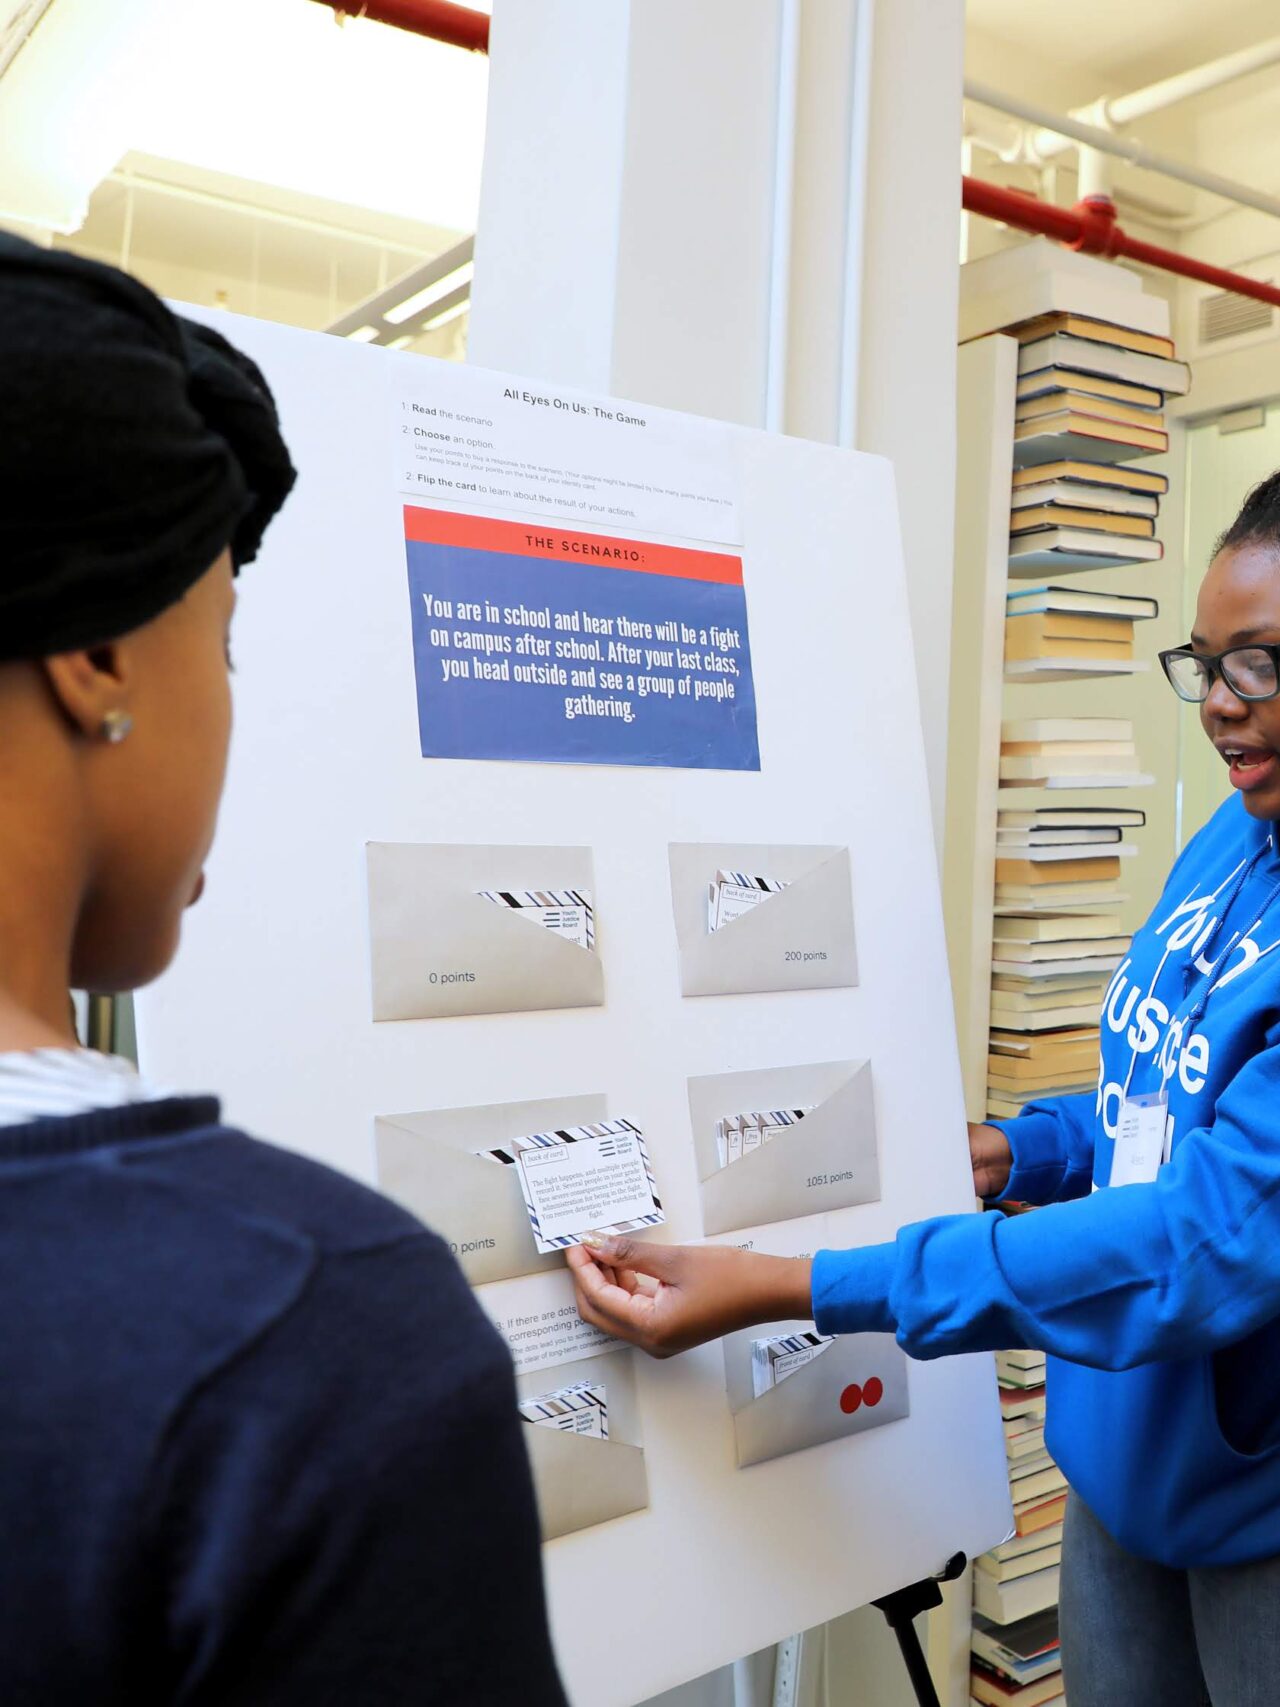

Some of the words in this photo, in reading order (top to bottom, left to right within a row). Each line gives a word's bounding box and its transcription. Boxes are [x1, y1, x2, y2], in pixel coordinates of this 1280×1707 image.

[412, 404, 437, 416] Read
[439, 406, 453, 420] the
[456, 414, 494, 427] scenario
[504, 388, 519, 400] All
[522, 392, 550, 407] Eyes
[553, 398, 569, 410] On
[572, 404, 590, 415] Us:
[594, 407, 613, 420] The
[616, 412, 646, 427] Game
[414, 428, 450, 442] Choose
[453, 436, 464, 444] an
[466, 438, 496, 450] option.
[429, 447, 442, 456] your
[418, 474, 436, 485] Flip
[438, 476, 453, 488] the
[456, 480, 477, 492] card
[479, 484, 487, 493] to
[489, 486, 512, 497] learn
[514, 490, 537, 501] about
[538, 492, 552, 504] the
[554, 496, 577, 508] result
[578, 500, 586, 509] of
[588, 503, 605, 513] your
[608, 506, 636, 518] actions.
[526, 536, 554, 550] THE
[562, 541, 645, 562] SCENARIO:
[423, 594, 452, 618] You
[457, 602, 481, 620] are
[485, 600, 500, 624] in
[504, 604, 550, 628] school
[554, 610, 580, 632] and
[582, 612, 614, 635] hear
[616, 616, 652, 639] there
[654, 621, 678, 642] will
[681, 623, 696, 644] be
[700, 630, 708, 646] a
[710, 626, 740, 652] fight
[430, 628, 450, 647] on
[454, 630, 512, 656] campus
[516, 632, 552, 656] after
[555, 638, 604, 662] school.
[608, 642, 642, 664] After
[646, 648, 674, 670] your
[676, 648, 702, 670] last
[704, 652, 740, 677] class,
[442, 658, 469, 682] you
[473, 656, 510, 682] head
[514, 662, 567, 686] outside
[571, 667, 596, 688] and
[600, 672, 623, 690] see
[626, 675, 634, 691] a
[638, 675, 674, 699] group
[678, 675, 691, 696] of
[694, 678, 735, 702] people
[565, 694, 636, 722] gathering.
[1155, 883, 1262, 995] Youh
[784, 950, 802, 961] 200
[804, 950, 828, 962] points
[429, 973, 438, 984] 0
[440, 972, 476, 986] points
[807, 1174, 828, 1188] 1051
[830, 1171, 854, 1184] points
[461, 1237, 496, 1255] points
[507, 1318, 514, 1328] If
[516, 1316, 538, 1327] there
[541, 1310, 556, 1320] are
[558, 1306, 577, 1317] dots
[508, 1321, 572, 1341] corresponding
